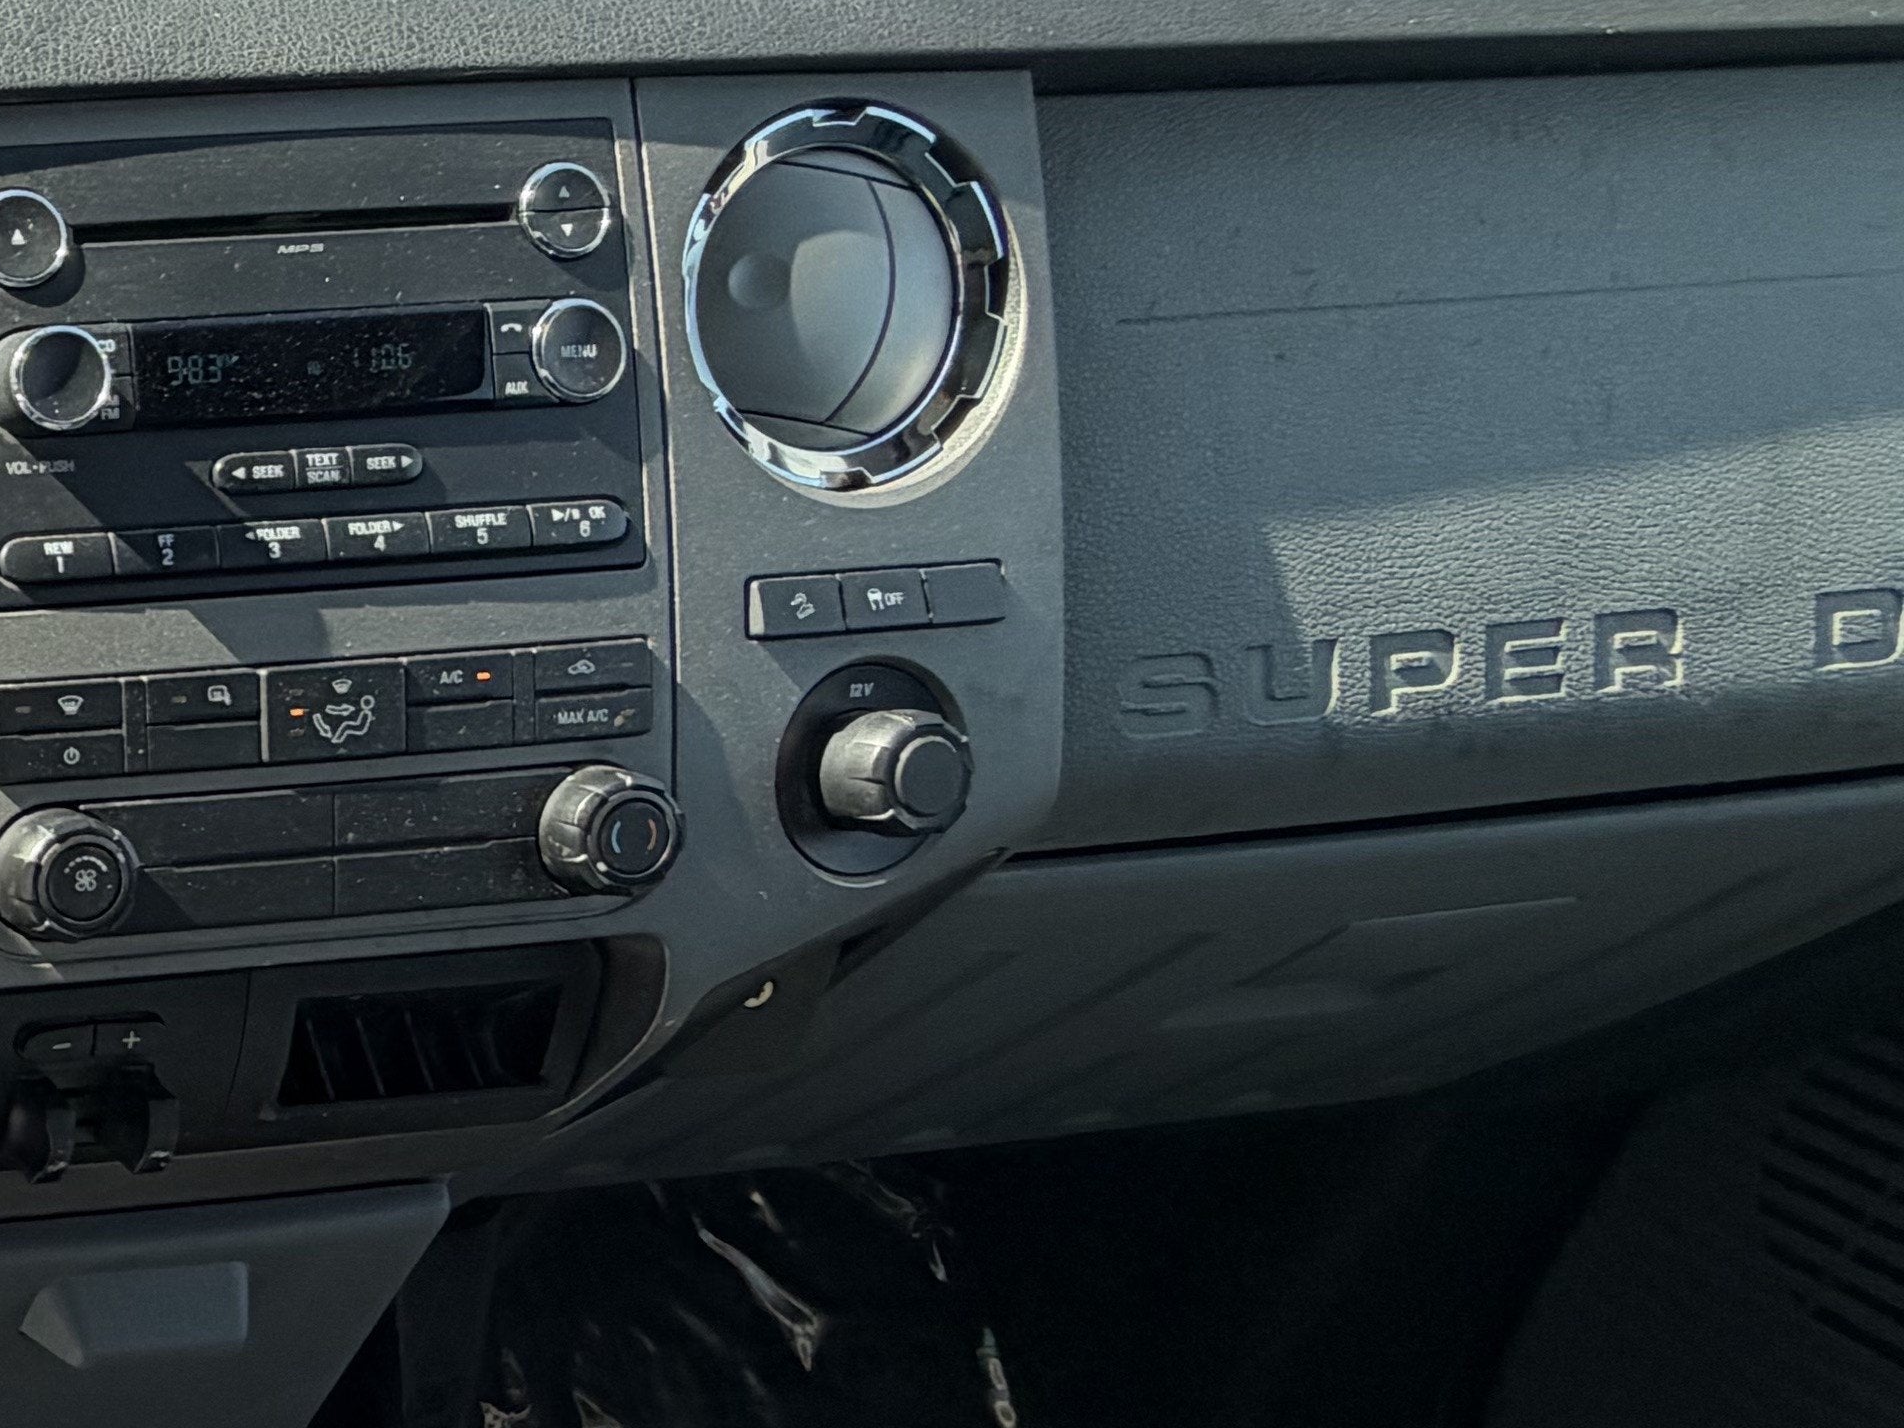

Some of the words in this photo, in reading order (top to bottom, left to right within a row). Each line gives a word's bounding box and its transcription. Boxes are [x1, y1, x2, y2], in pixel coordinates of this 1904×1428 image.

[560, 345, 598, 359] MENU
[504, 380, 529, 396] AUX
[100, 407, 121, 421] FM
[305, 452, 340, 468] TEXT
[365, 455, 397, 471] SEEK
[252, 464, 284, 480] SEEK
[306, 468, 341, 484] SCAN
[348, 519, 393, 537] FOLDER
[454, 512, 508, 529] SHUFFLE
[256, 525, 301, 542] FOLDER
[476, 527, 489, 545] 5
[578, 520, 591, 538] 6
[42, 540, 75, 556] REW
[157, 533, 175, 548] FF
[372, 534, 386, 553] 4
[160, 548, 175, 567] 2
[268, 541, 281, 560] 3
[55, 555, 66, 574] 1
[883, 591, 906, 606] OFF
[438, 669, 464, 685] A/C
[1117, 606, 1688, 742] SUPER
[556, 709, 585, 726] MAX
[586, 708, 610, 723] A/C
